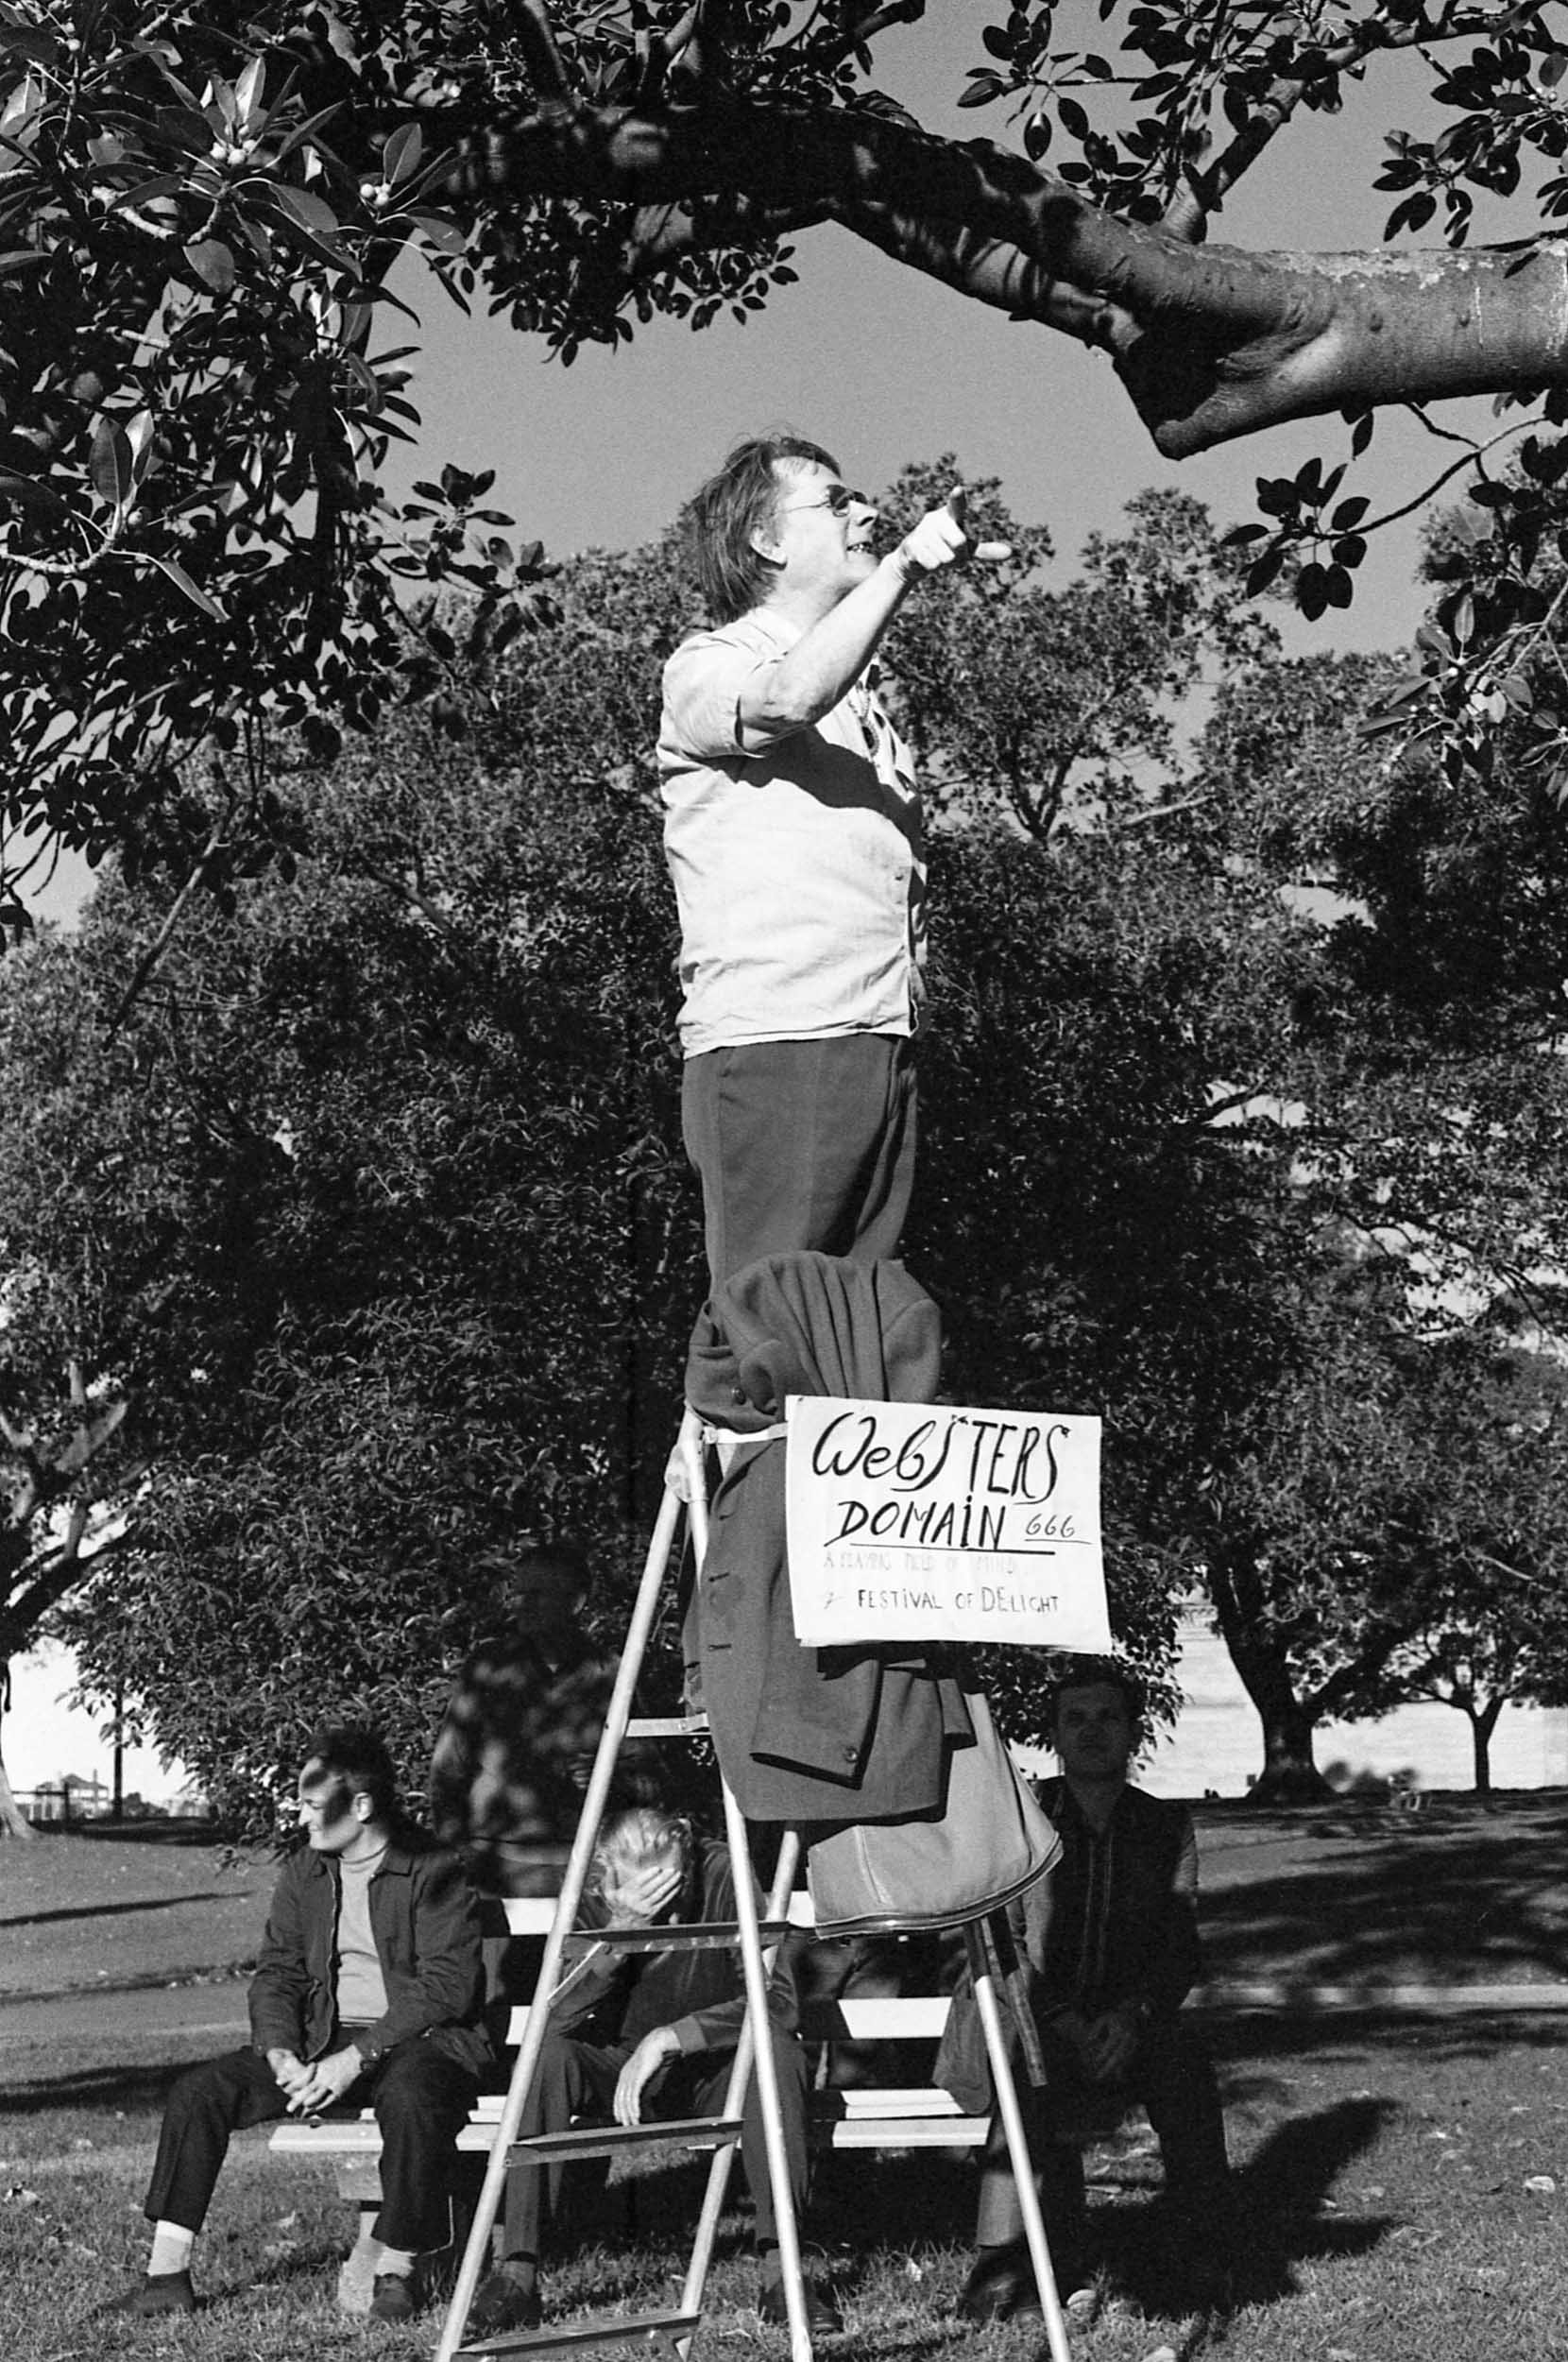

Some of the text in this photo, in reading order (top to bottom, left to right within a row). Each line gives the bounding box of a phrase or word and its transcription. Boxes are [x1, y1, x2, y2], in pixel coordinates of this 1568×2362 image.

[1025, 1513, 1076, 1539] 666
[954, 1591, 975, 1611] OF
[980, 1585, 1060, 1614] DELIGHT
